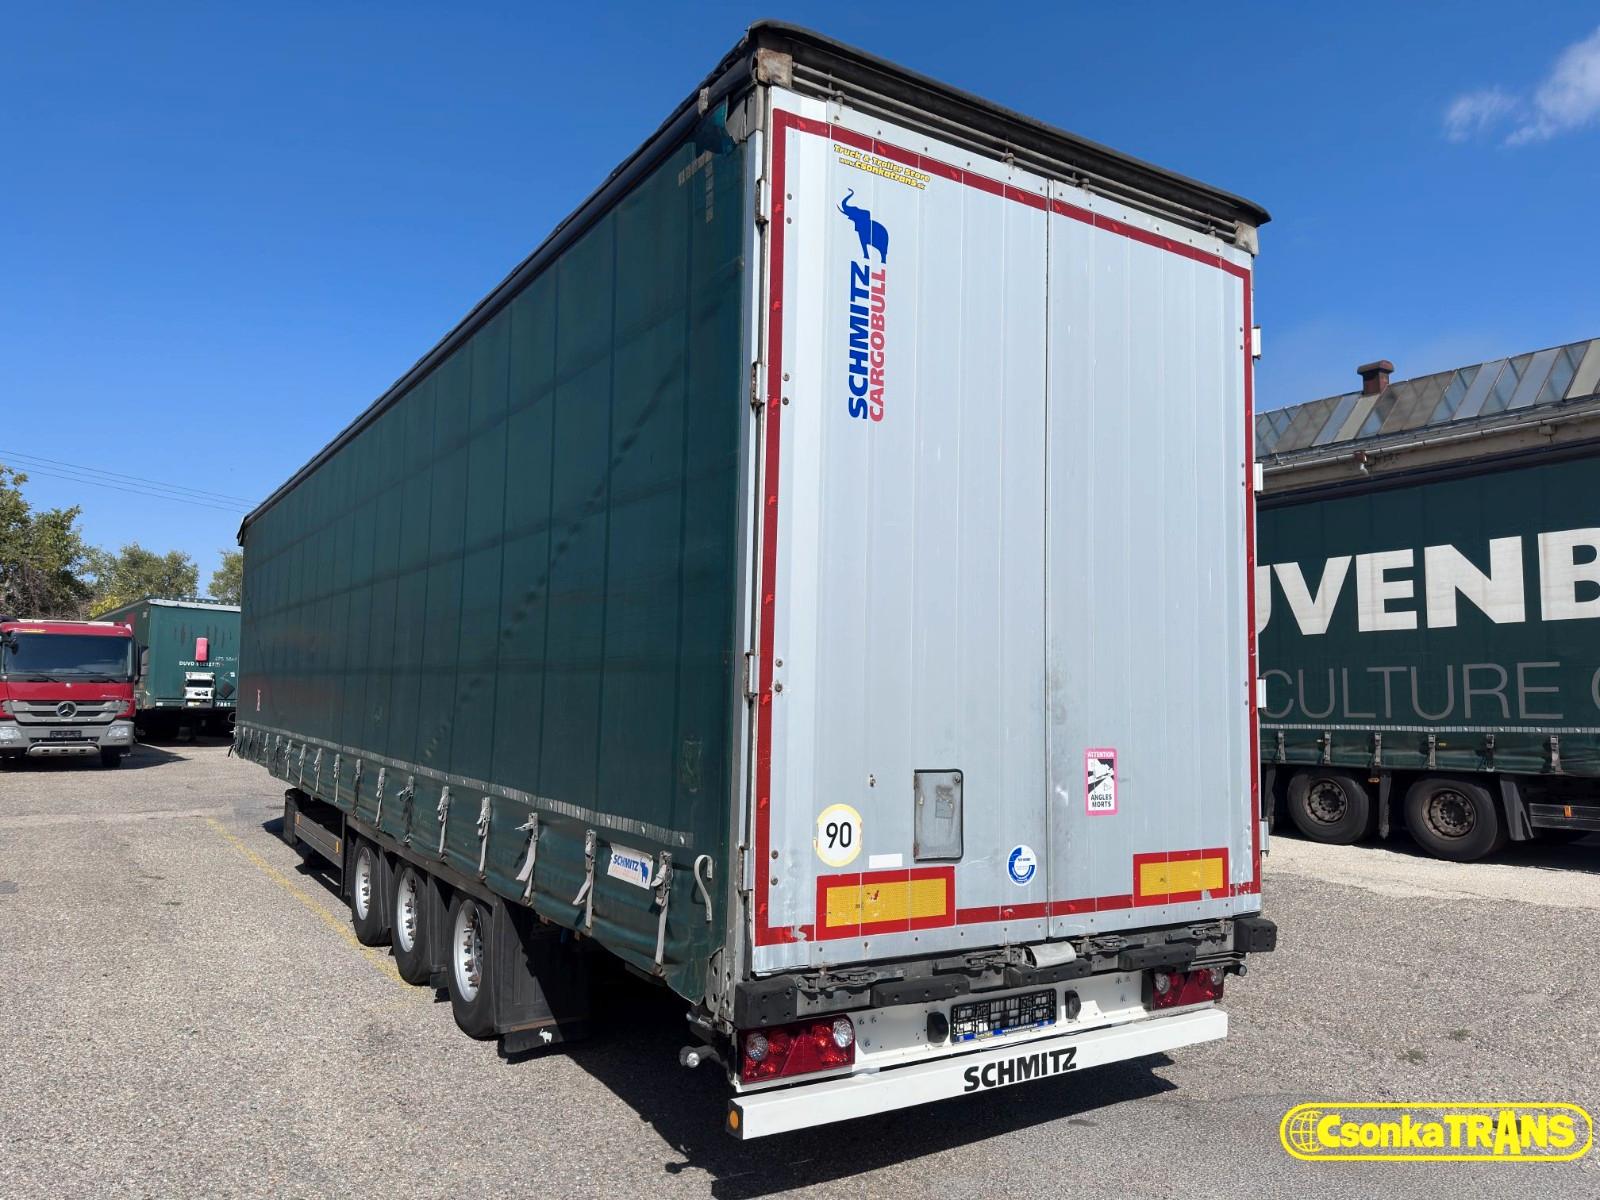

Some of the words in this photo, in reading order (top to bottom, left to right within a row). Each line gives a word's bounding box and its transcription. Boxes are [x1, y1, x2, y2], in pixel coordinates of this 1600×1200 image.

[834, 144, 862, 161] Truck
[863, 154, 870, 163] &
[872, 157, 903, 173] Trailer
[904, 168, 931, 183] Store
[848, 261, 870, 419] SCHMITZ
[870, 269, 886, 422] CARGOBULL
[1257, 528, 1600, 635] VENB
[1260, 662, 1564, 720] CULTURE
[826, 822, 852, 848] 90
[613, 855, 640, 871] SCHMITZ
[964, 1046, 1077, 1092] SCHMITZ
